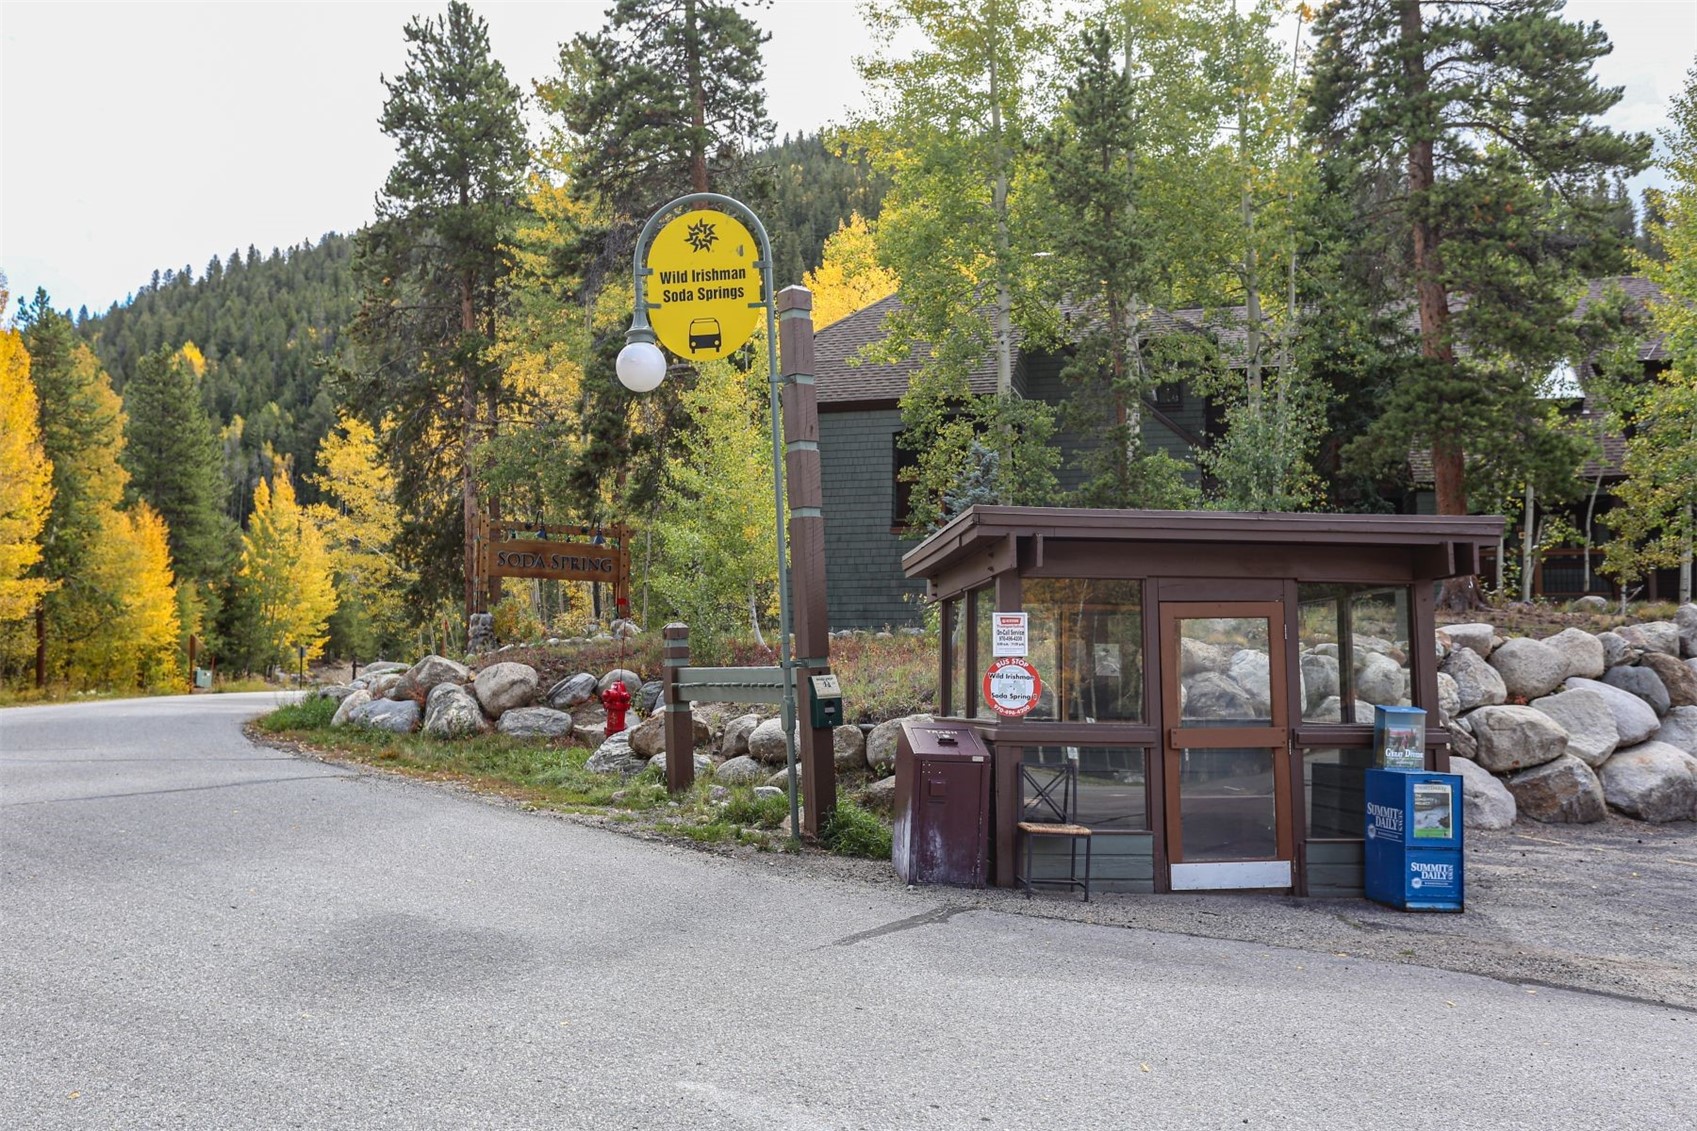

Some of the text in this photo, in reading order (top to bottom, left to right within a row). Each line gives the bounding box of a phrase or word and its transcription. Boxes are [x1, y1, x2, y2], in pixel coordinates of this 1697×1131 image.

[660, 268, 746, 284] Wild Irishman
[663, 286, 744, 302] Soda Springs
[498, 550, 612, 572] SODA SPRING
[996, 658, 1029, 668] BUS STOP
[1367, 802, 1398, 819] SUMMIT
[1375, 816, 1398, 830] DAILY
[1411, 862, 1448, 872] SUMMIT
[1421, 872, 1448, 880] DAILY
